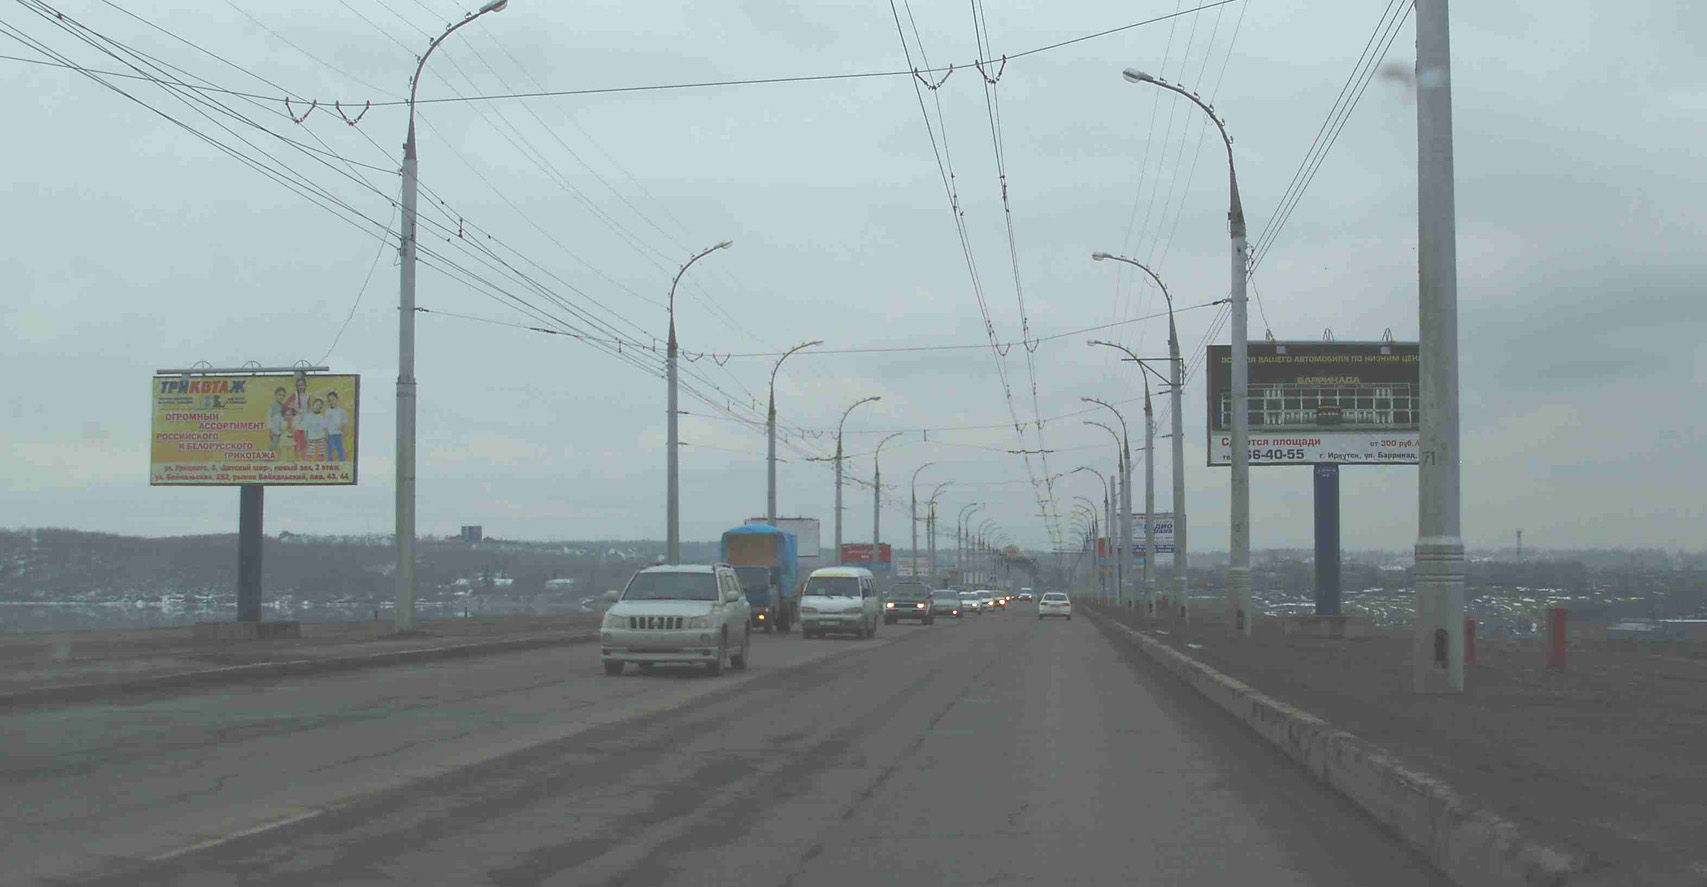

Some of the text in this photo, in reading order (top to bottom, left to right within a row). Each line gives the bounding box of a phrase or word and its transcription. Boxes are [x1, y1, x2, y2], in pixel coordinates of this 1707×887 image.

[161, 380, 246, 394] ТРИКОТАЖ
[165, 412, 219, 421] ОГРОМНЫЙ
[200, 422, 265, 430] АССОРТИМЕНТ
[156, 431, 219, 440] РОССИЙСКОГО
[1273, 438, 1320, 447] площади
[224, 452, 276, 460] ТРИКОТАЖА
